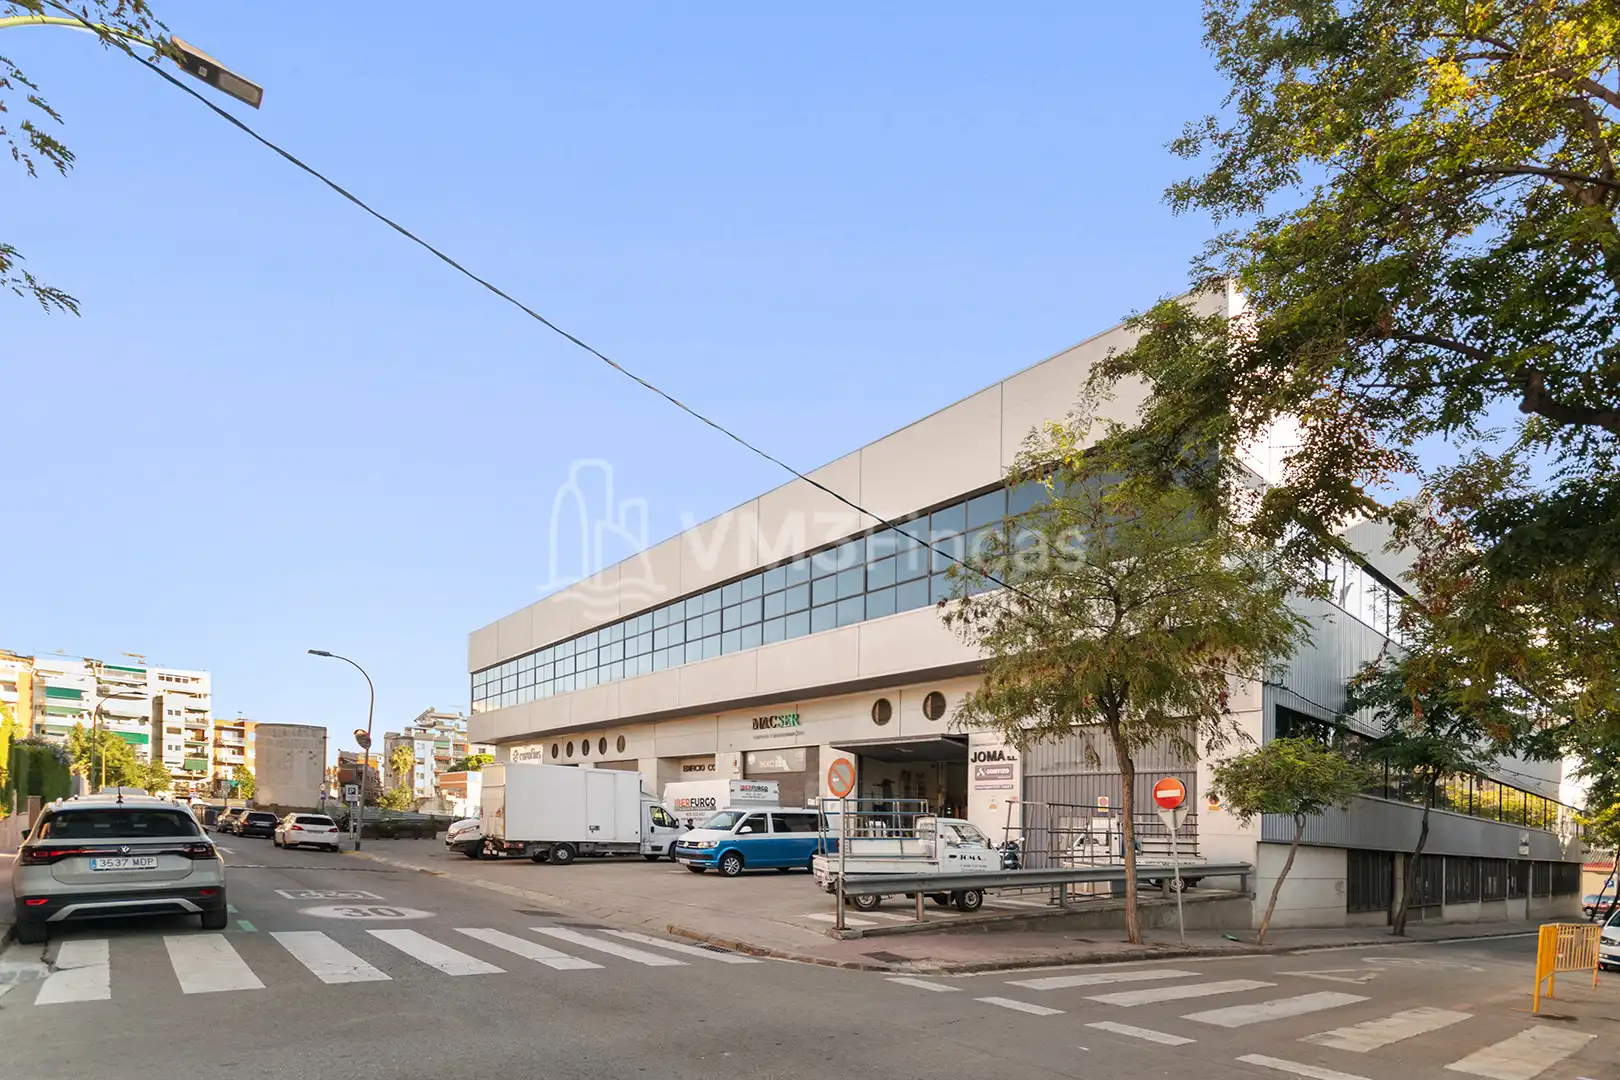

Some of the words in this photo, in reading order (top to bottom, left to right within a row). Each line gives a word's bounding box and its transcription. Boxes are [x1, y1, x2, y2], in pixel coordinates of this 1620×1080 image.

[752, 713, 801, 730] MACSER
[970, 750, 1006, 763] JOMA
[674, 797, 717, 807] IBERFURGO
[100, 859, 128, 867] 3537
[333, 907, 405, 917] 30
